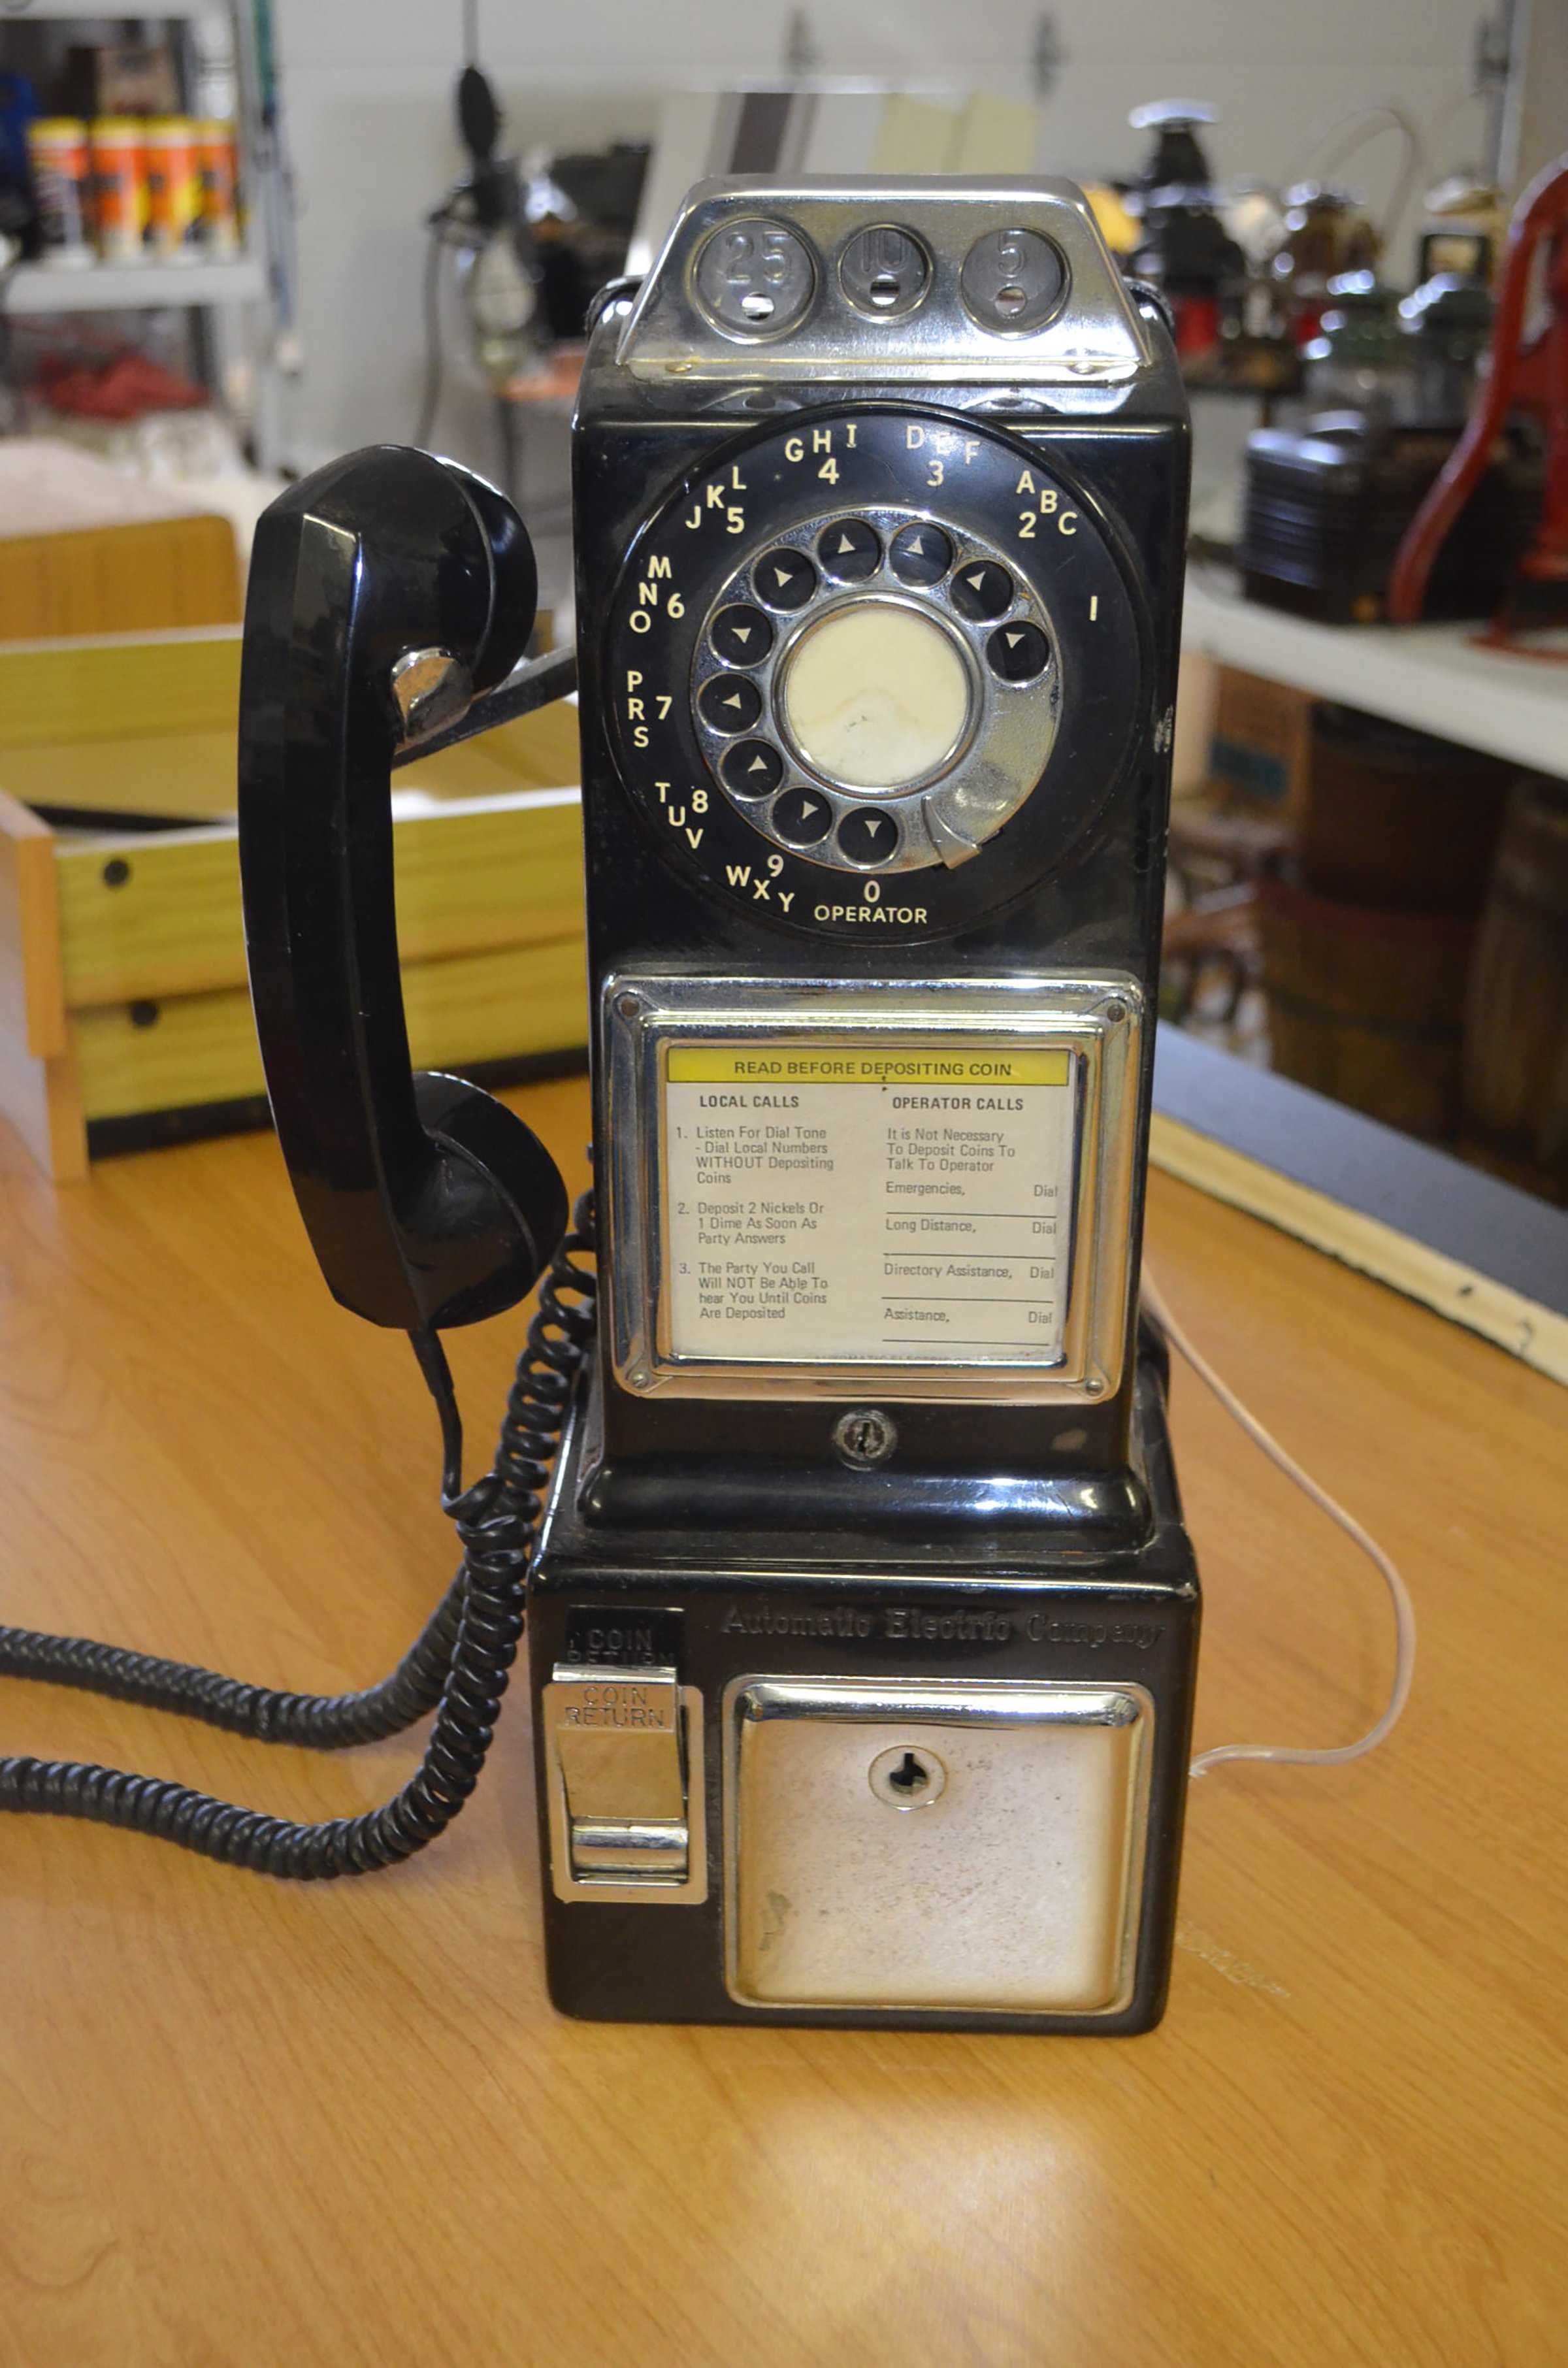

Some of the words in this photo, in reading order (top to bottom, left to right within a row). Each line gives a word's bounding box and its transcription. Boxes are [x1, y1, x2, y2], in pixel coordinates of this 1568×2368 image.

[725, 231, 791, 285] 25
[860, 230, 906, 274] 10
[996, 231, 1026, 278] 5
[818, 463, 840, 485] 4
[926, 462, 945, 486] 3
[726, 507, 745, 534] 5
[1019, 512, 1037, 538] 2
[666, 593, 685, 619] 6
[656, 696, 672, 720] 7
[691, 789, 709, 814] 8
[767, 854, 784, 878] 9
[864, 880, 880, 902] 0
[814, 904, 928, 924] OPERATOR
[734, 1062, 782, 1074] READ
[787, 1062, 855, 1074] BEFORE
[861, 1062, 964, 1076] DEPOSITING
[970, 1064, 1011, 1076] COIN
[700, 1095, 747, 1108] LOCAL
[753, 1096, 800, 1108] CALLS
[892, 1097, 971, 1110] OPERATOR
[977, 1098, 1024, 1111] CALLS
[677, 1127, 687, 1138] 1.
[696, 1126, 734, 1139] Listen
[740, 1126, 760, 1138] For
[766, 1126, 790, 1138] Dial
[795, 1127, 826, 1139] Tone
[888, 1128, 897, 1140] It
[901, 1129, 911, 1140] is
[915, 1128, 938, 1141] Not
[943, 1129, 1004, 1143] Necessary
[705, 1142, 728, 1154] Dial
[734, 1142, 767, 1154] Local
[772, 1142, 828, 1154] Numbers
[887, 1143, 903, 1155] To
[909, 1143, 955, 1157] Deposit
[960, 1145, 994, 1157] Coins
[999, 1145, 1015, 1157] To
[696, 1157, 762, 1169] WITHOUT
[769, 1157, 834, 1171] Depositing
[887, 1158, 913, 1170] Talk
[919, 1159, 935, 1171] To
[940, 1159, 994, 1174] Operator
[697, 1172, 731, 1185] Coins
[886, 1181, 966, 1196] Emergencies,
[1034, 1185, 1058, 1197] Dial
[678, 1202, 690, 1215] 2.
[698, 1202, 744, 1216] Deposit
[749, 1202, 756, 1214] 2
[761, 1202, 805, 1214] Nickels
[809, 1202, 825, 1214] Or
[699, 1218, 704, 1228] 1
[710, 1217, 742, 1229] Dime
[747, 1217, 762, 1229] As
[766, 1217, 797, 1229] Soon
[801, 1217, 817, 1229] As
[886, 1219, 916, 1233] Long
[921, 1219, 976, 1233] Distance,
[1032, 1221, 1057, 1234] Dial
[698, 1232, 730, 1246] Party
[735, 1233, 786, 1244] Answers
[679, 1263, 691, 1274] 3.
[698, 1262, 721, 1274] The
[726, 1262, 758, 1275] Party
[763, 1262, 788, 1274] You
[792, 1262, 815, 1274] Call
[885, 1263, 942, 1277] Directory
[947, 1264, 1012, 1279] Assistance,
[1030, 1266, 1054, 1279] Dial
[698, 1277, 721, 1289] Will
[727, 1277, 755, 1289] NOT
[760, 1277, 776, 1289] Be
[779, 1277, 808, 1289] Able
[811, 1277, 828, 1289] To
[699, 1292, 724, 1304] hear
[730, 1292, 755, 1304] You
[759, 1292, 789, 1304] Until
[794, 1292, 827, 1304] Coins
[700, 1307, 721, 1319] Are
[725, 1307, 786, 1321] Deposited
[884, 1308, 950, 1323] Assistance,
[1028, 1311, 1053, 1324] Dial
[721, 1604, 870, 1637] Automatic
[885, 1607, 1011, 1640] Electric
[1027, 1613, 1166, 1649] Company
[584, 1686, 647, 1707] COIN
[564, 1707, 664, 1728] RETURN
